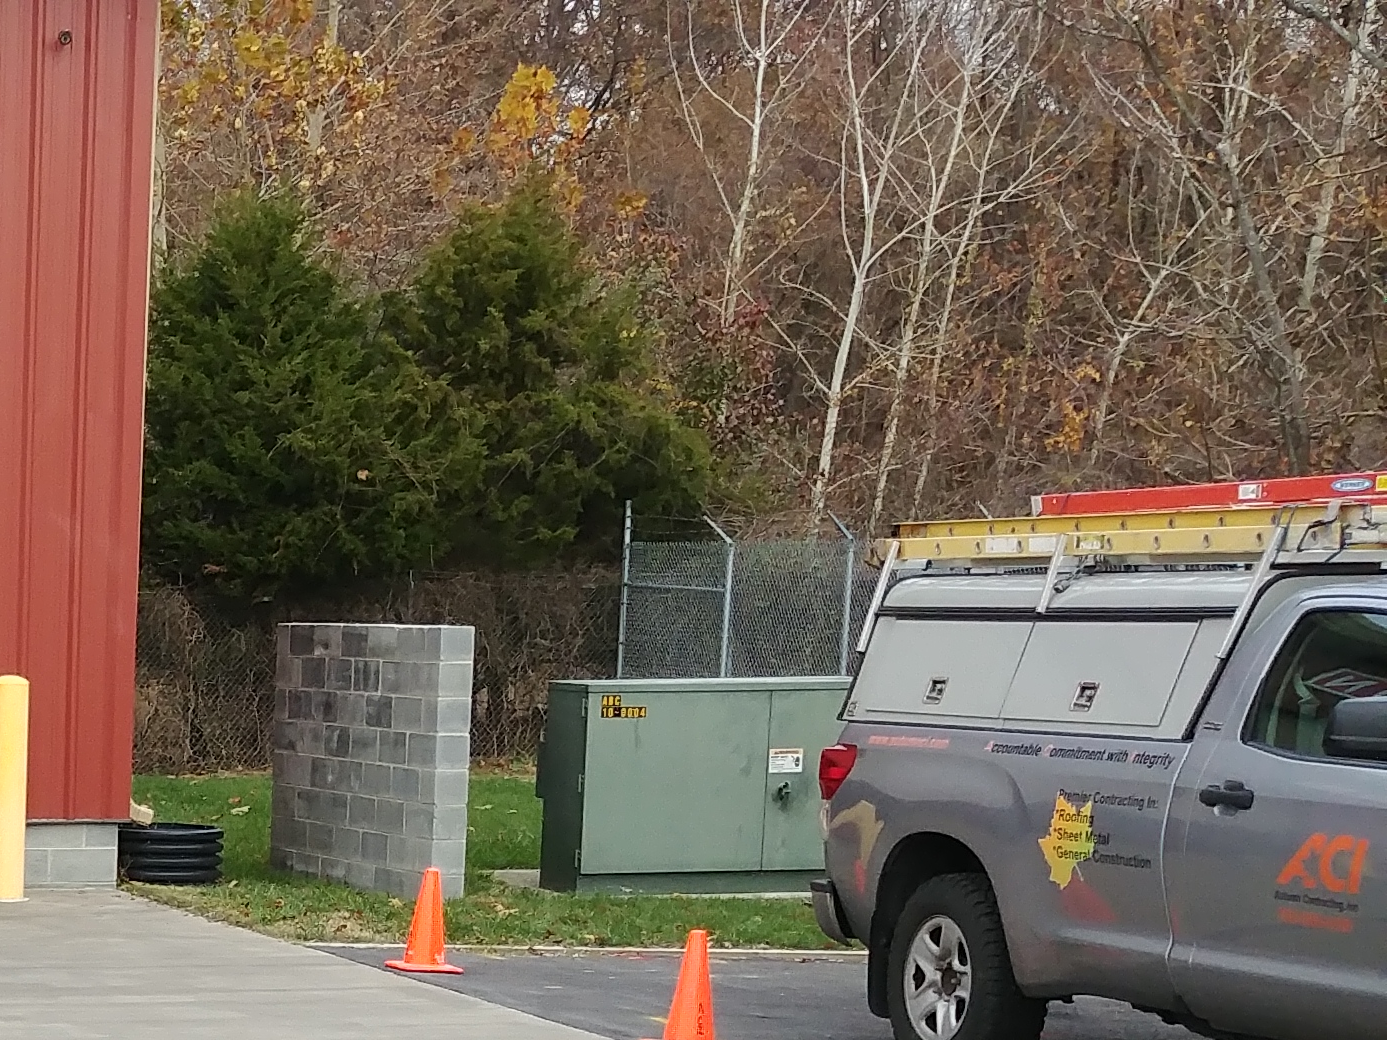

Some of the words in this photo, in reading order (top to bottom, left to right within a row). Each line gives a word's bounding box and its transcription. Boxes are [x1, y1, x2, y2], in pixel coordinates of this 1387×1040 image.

[984, 741, 1042, 757] Accountable
[1106, 749, 1129, 763] with
[1129, 750, 1176, 770] Integrity
[1058, 788, 1092, 803] Premier
[1093, 791, 1145, 812] Contracting
[1085, 830, 1110, 846] Metal
[1091, 849, 1152, 870] Construction
[1276, 832, 1368, 895] ACI
